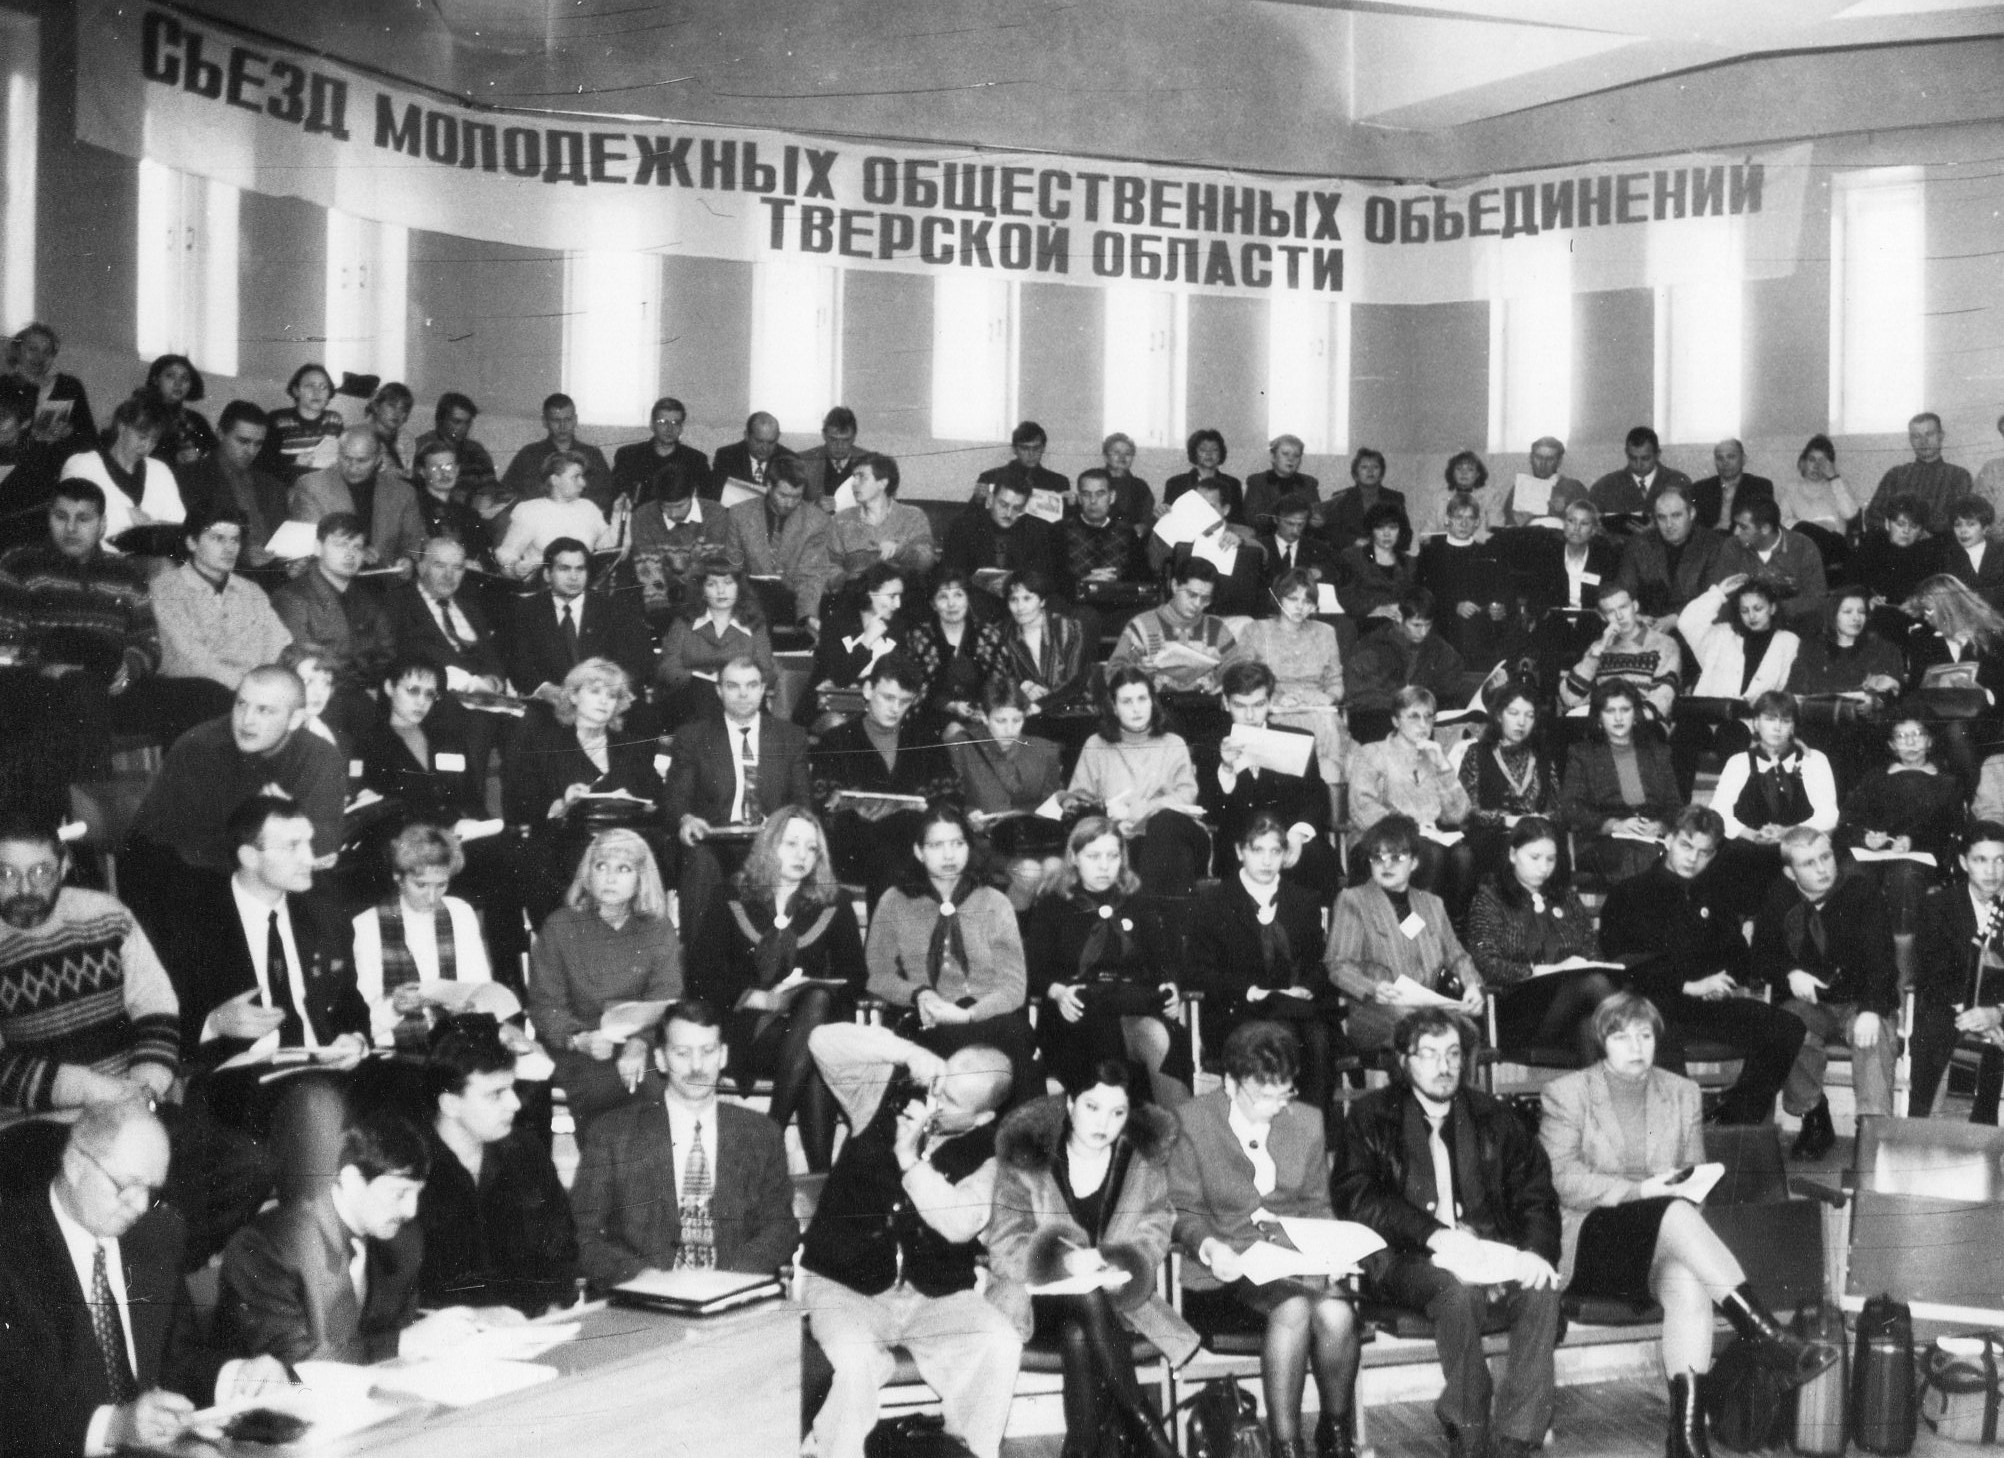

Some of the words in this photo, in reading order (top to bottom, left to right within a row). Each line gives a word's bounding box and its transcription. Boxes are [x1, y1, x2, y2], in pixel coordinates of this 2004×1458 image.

[374, 94, 839, 200] МОЛОДЕЖНЫХ
[862, 155, 1342, 241] ОБЩЕСТВЕННЫХ
[759, 197, 1070, 273] ТВЕРСКОЙ
[1091, 229, 1343, 292] ОБЛАСТИ
